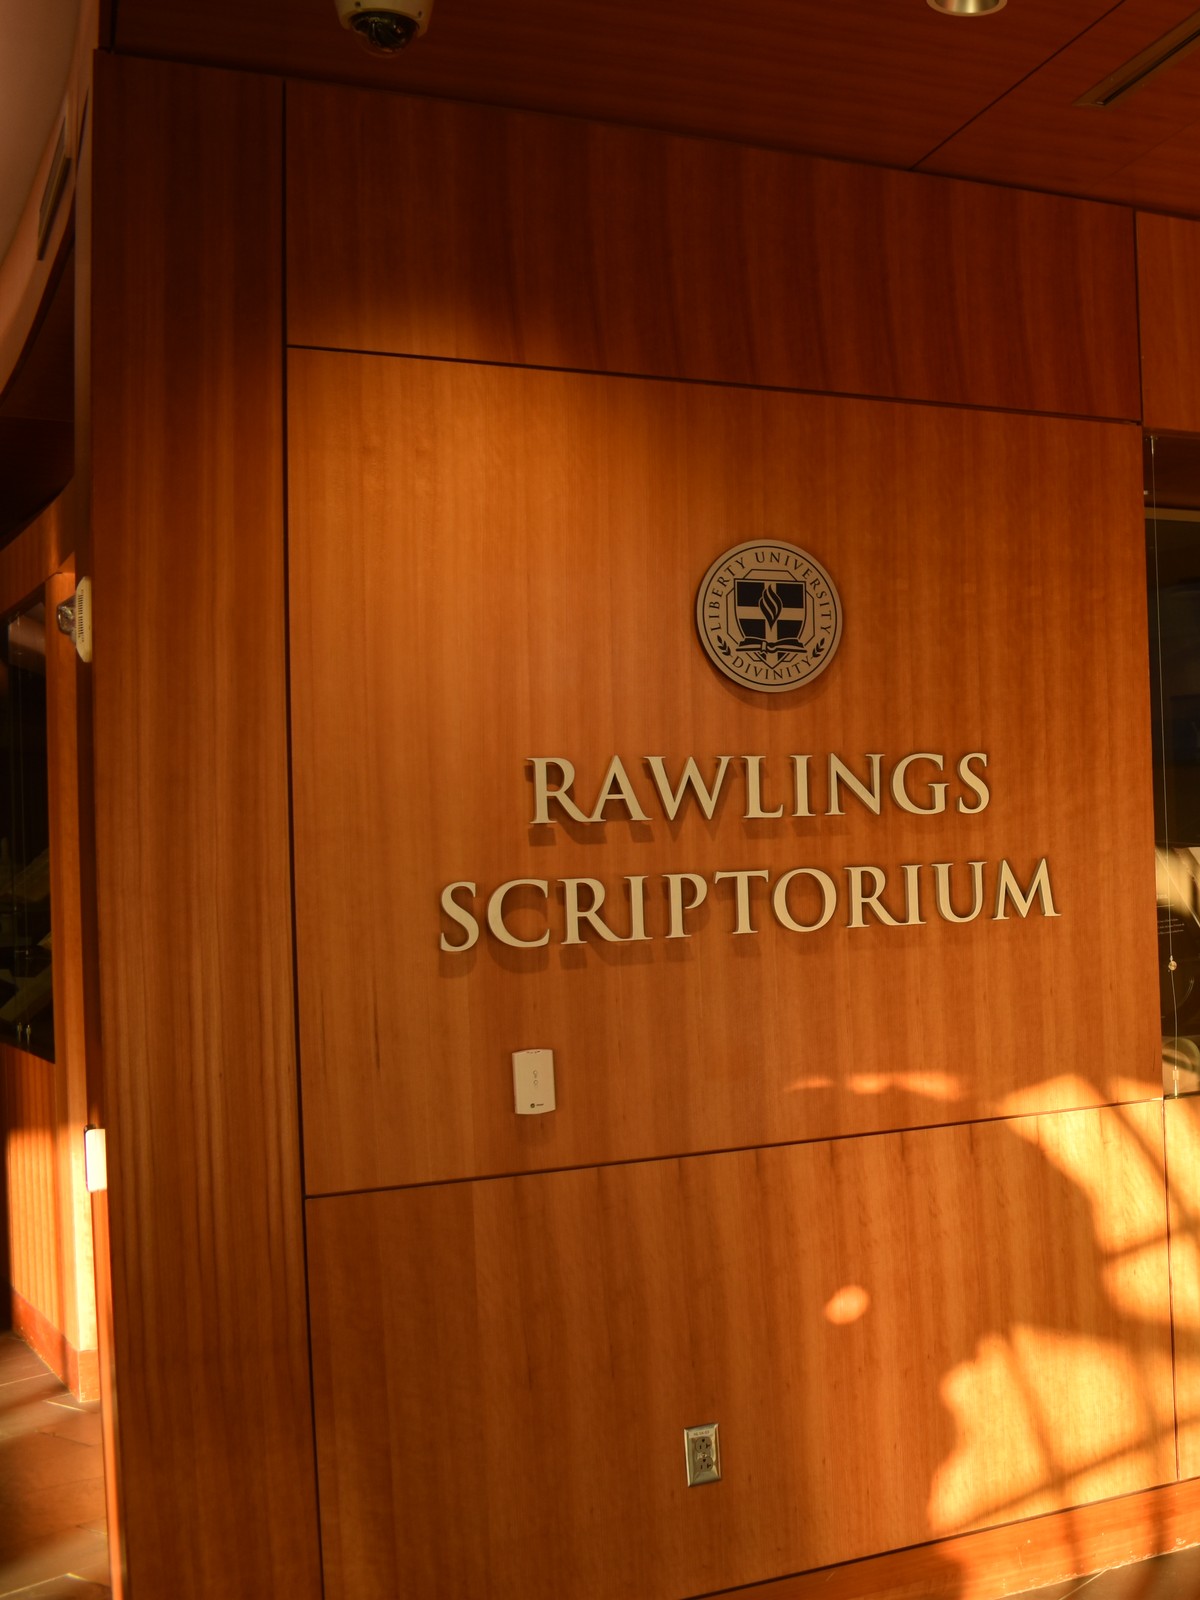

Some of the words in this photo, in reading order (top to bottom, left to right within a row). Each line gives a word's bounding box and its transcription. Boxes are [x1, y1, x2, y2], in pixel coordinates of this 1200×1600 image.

[709, 557, 745, 631] LIBERTY
[755, 552, 832, 634] UNIVERSITY
[732, 655, 813, 680] DIVINITY
[525, 752, 991, 824] RAWLINGS
[440, 857, 1062, 953] SCRIPTORIUM
